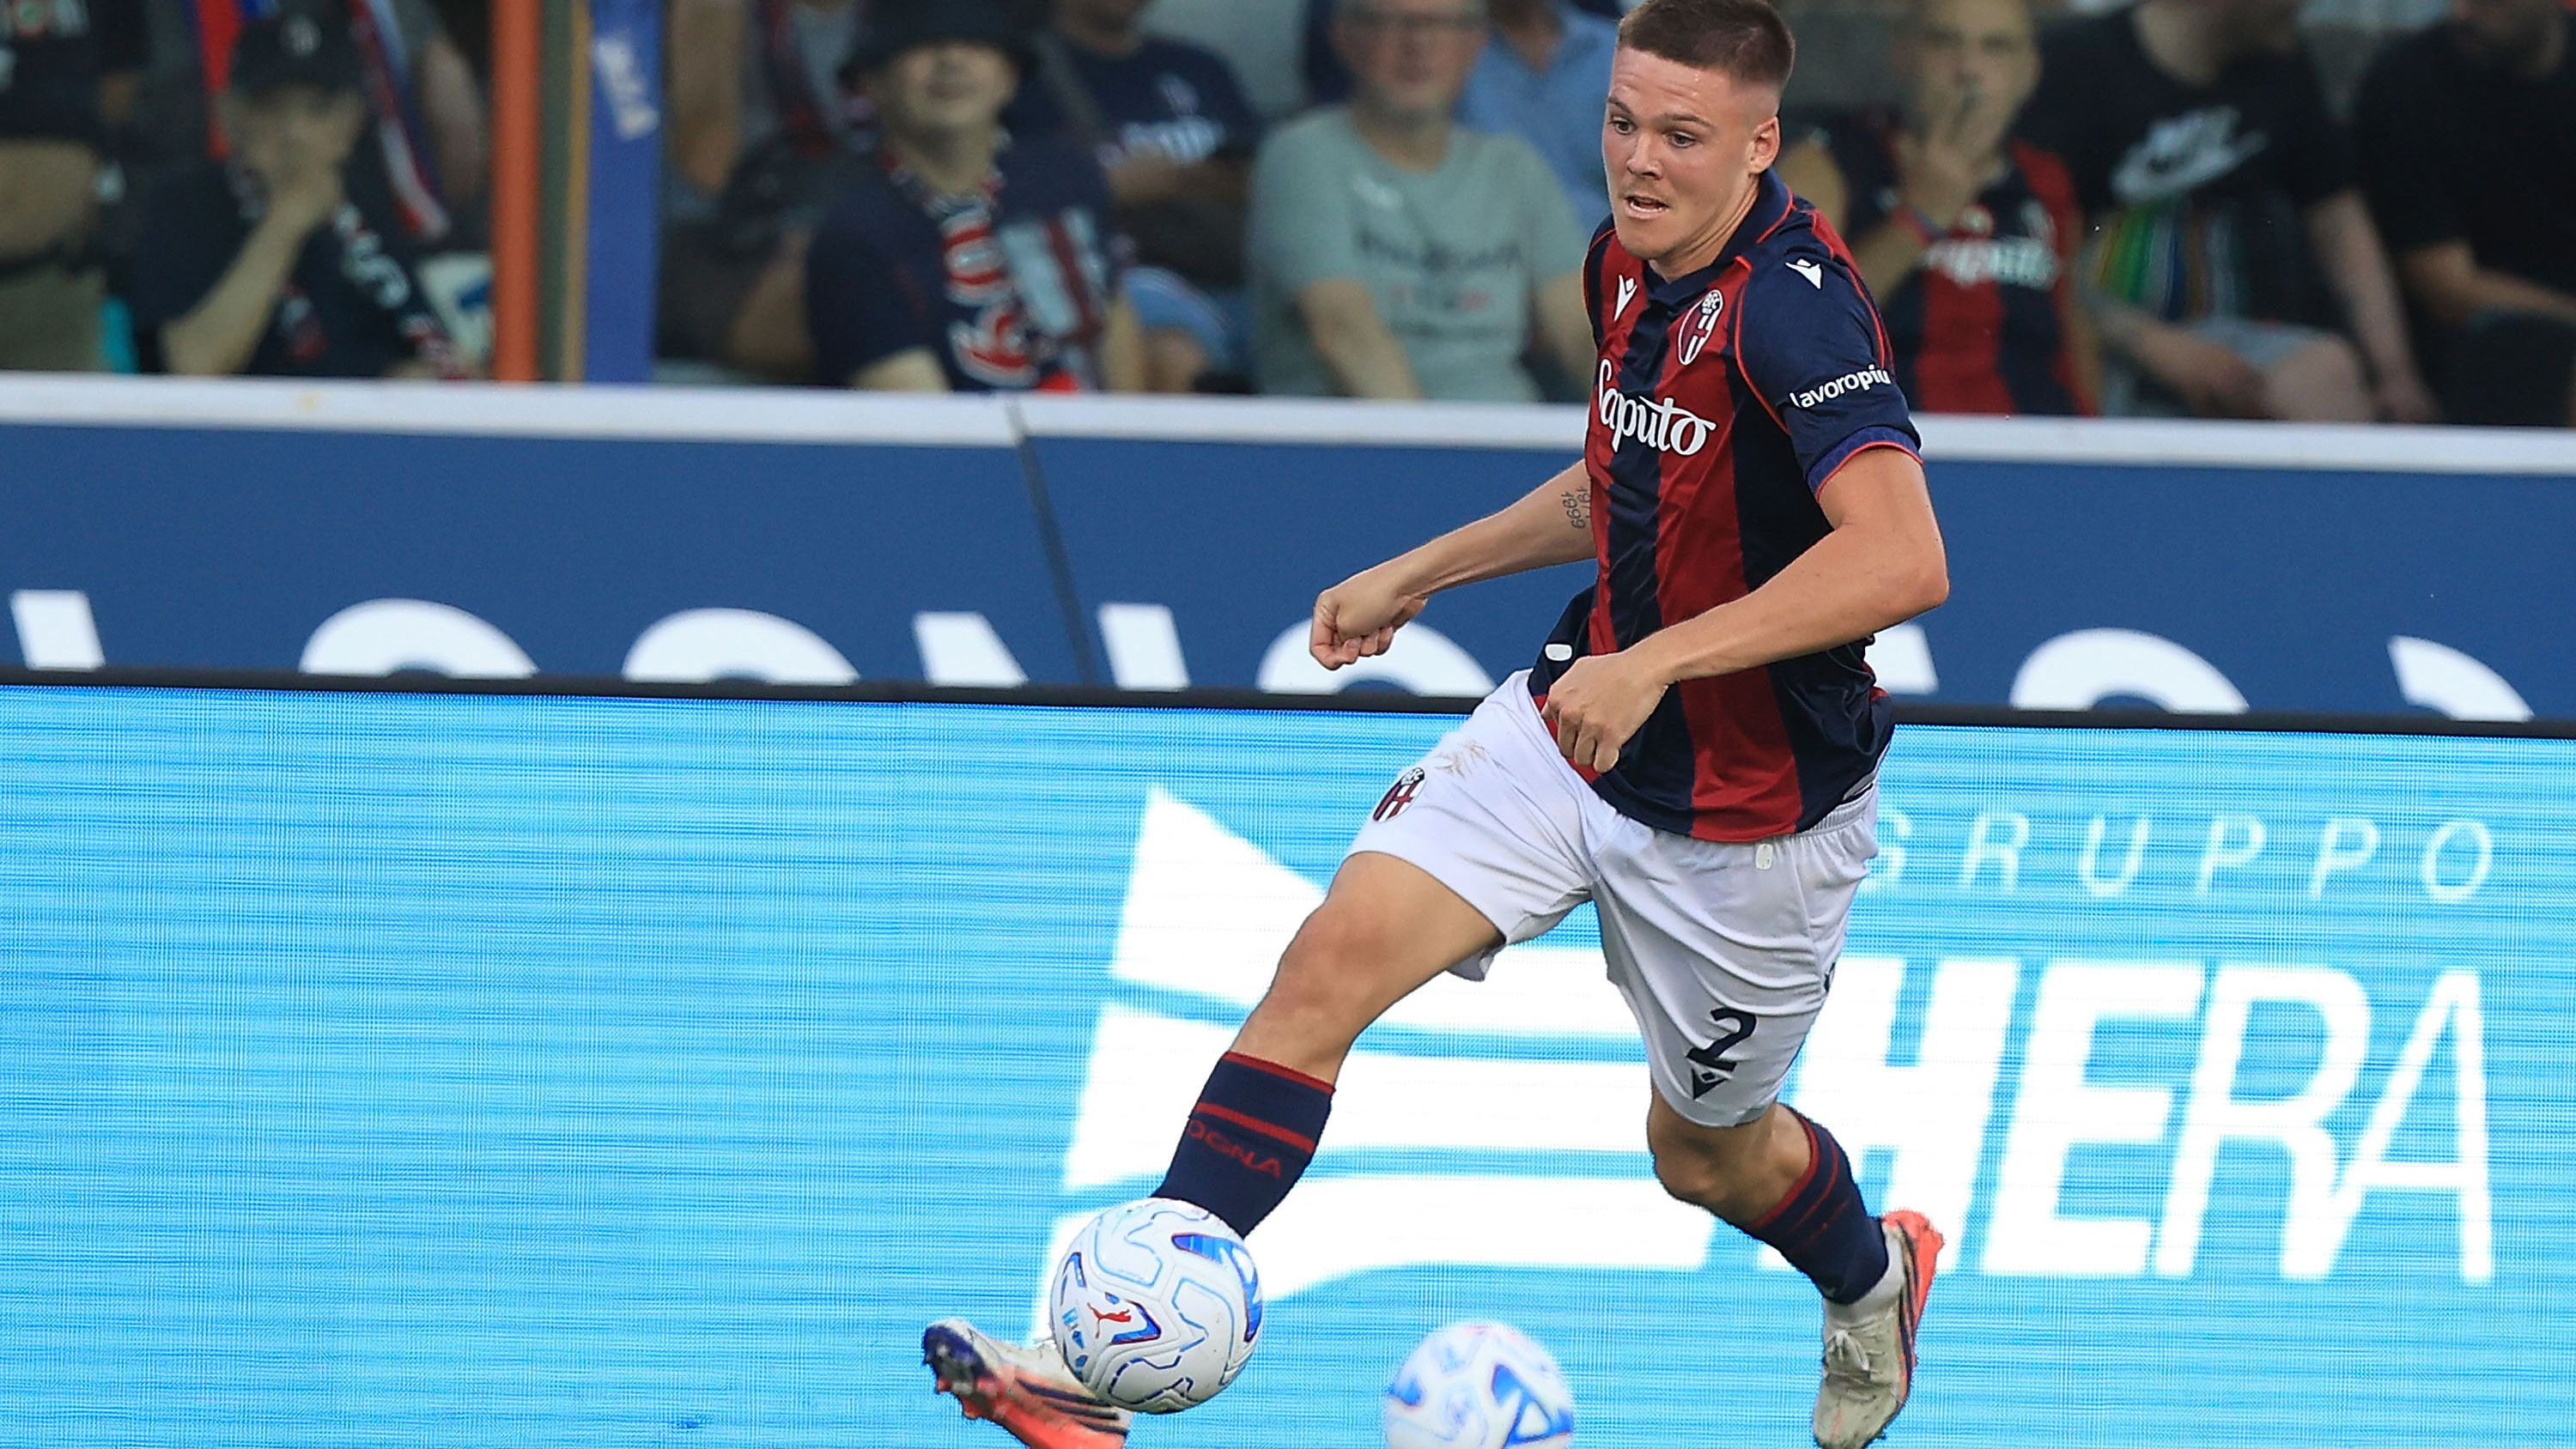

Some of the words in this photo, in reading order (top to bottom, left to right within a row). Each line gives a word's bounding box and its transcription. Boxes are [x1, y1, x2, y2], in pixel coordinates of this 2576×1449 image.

[1599, 359, 1716, 456] Saputo
[1856, 810, 2494, 902] GRUPPO
[1686, 1007, 1757, 1070] 2
[1757, 955, 2494, 1286] HERA
